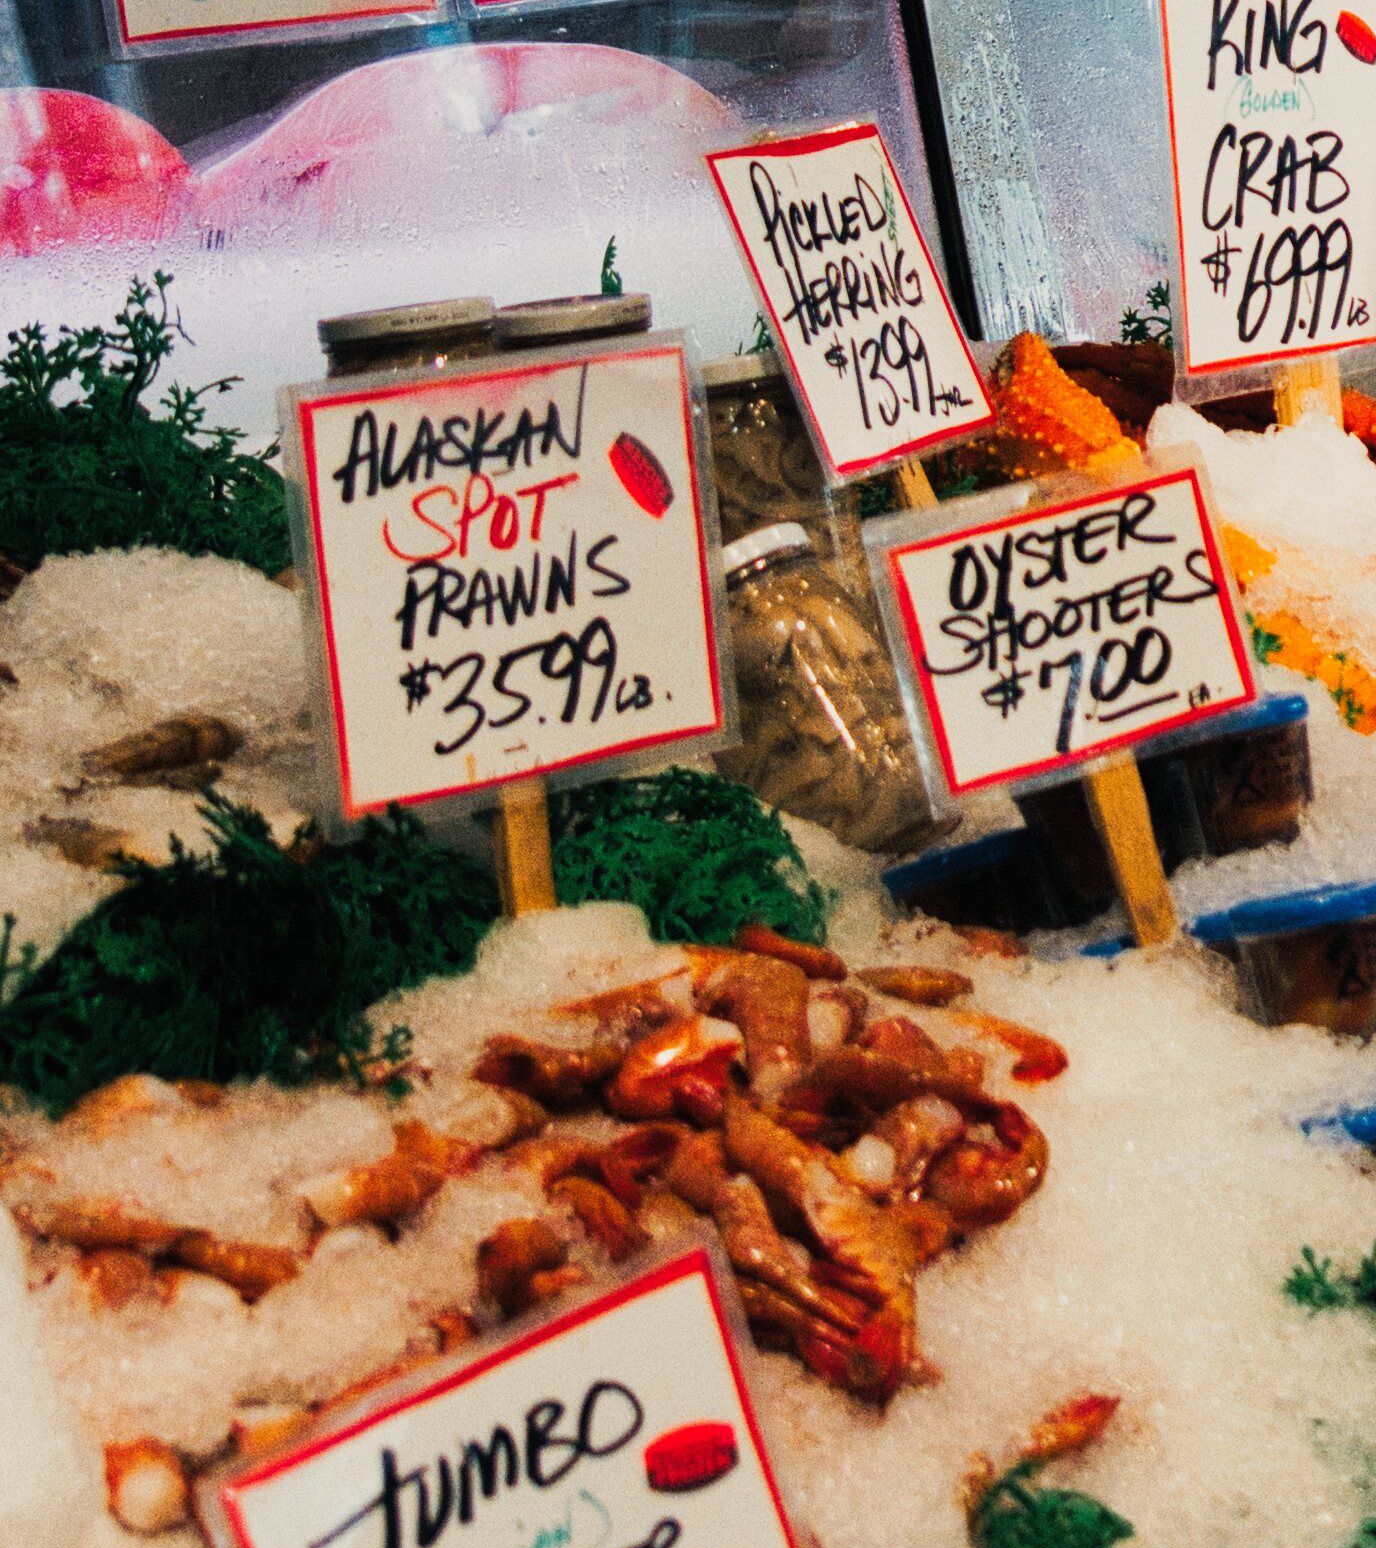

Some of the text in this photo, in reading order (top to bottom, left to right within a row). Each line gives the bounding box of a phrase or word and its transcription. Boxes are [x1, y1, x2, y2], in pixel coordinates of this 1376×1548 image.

[1200, 121, 1351, 233] CRAB
[783, 241, 926, 346] HERRING
[1201, 216, 1355, 346] $69.99
[332, 362, 589, 504] ALASKAN
[824, 315, 936, 430] $13.99
[382, 471, 581, 562] SPOT
[949, 491, 1176, 619] OYSTER
[395, 529, 632, 651] PRAWNS
[923, 549, 1220, 676] SHOOTERS
[400, 616, 618, 755] $35.99
[980, 627, 1180, 754] $7.00
